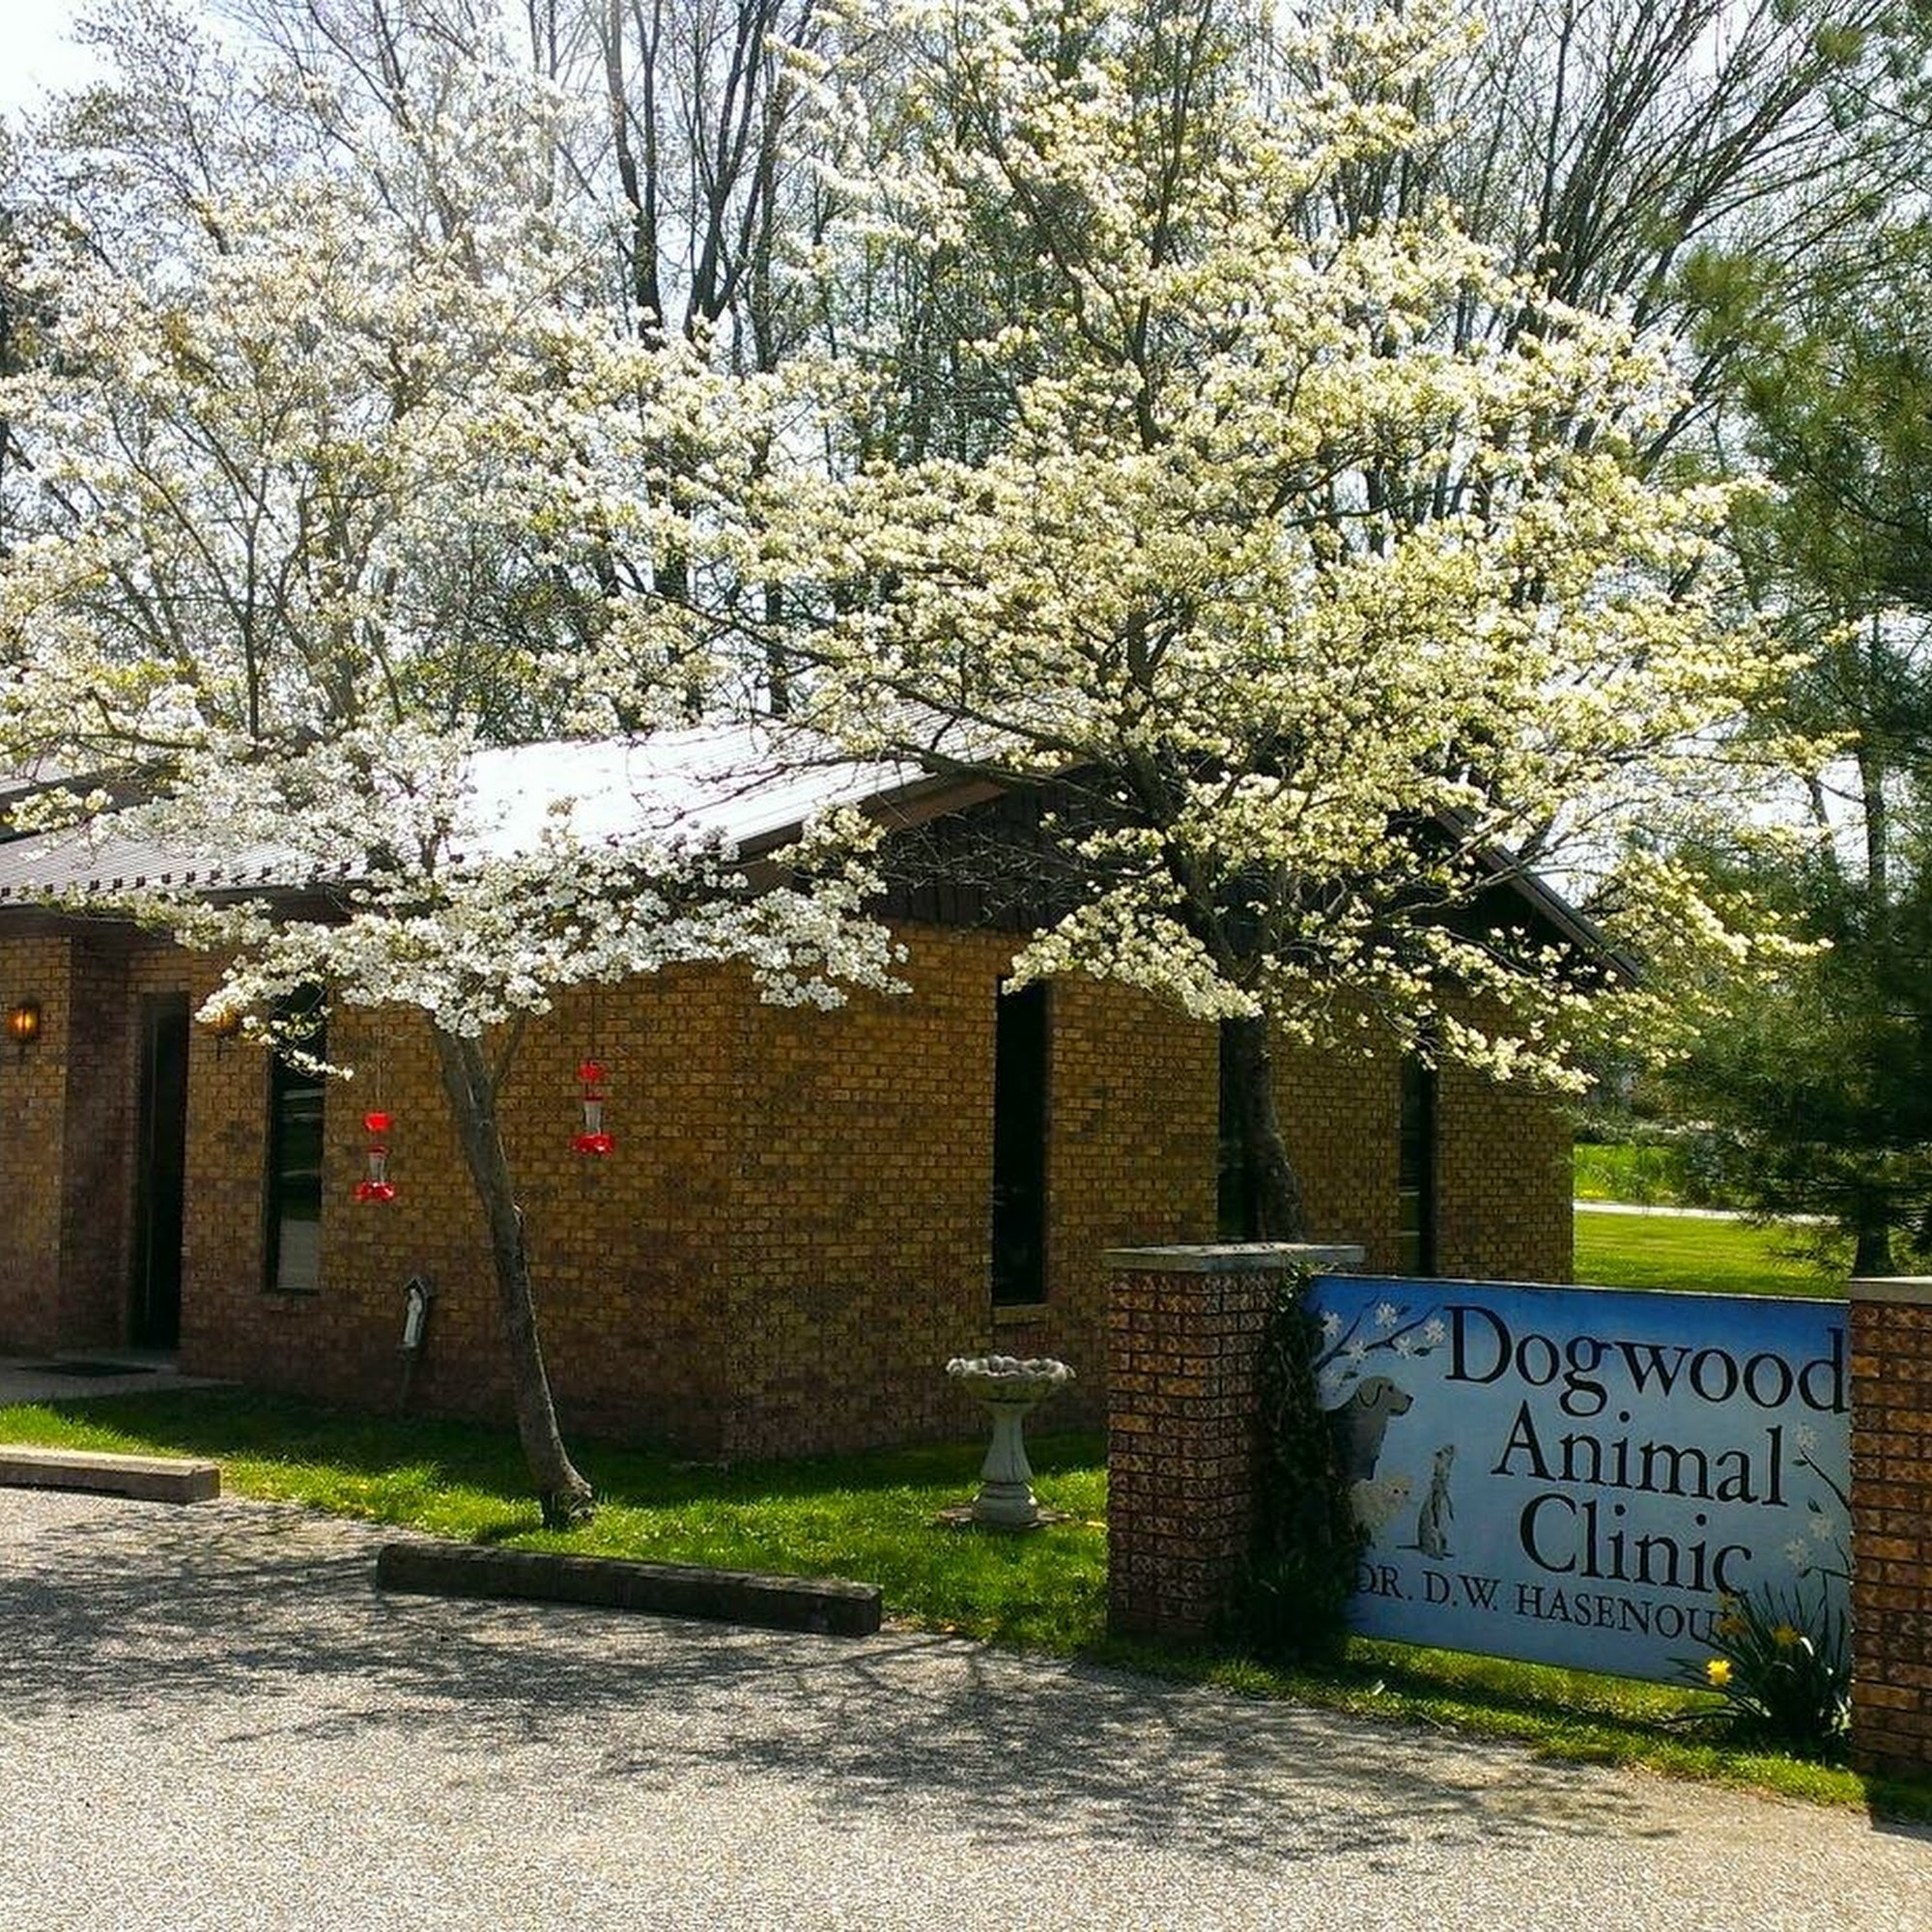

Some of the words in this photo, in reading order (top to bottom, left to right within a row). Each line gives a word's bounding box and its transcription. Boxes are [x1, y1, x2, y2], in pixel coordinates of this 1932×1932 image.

[1443, 1304, 1850, 1416] Dogwood
[1491, 1399, 1788, 1508] Animal
[1520, 1493, 1752, 1597] Clinic
[1352, 1560, 1412, 1601] DR.
[1422, 1570, 1500, 1611] D.W.
[1516, 1582, 1729, 1644] HASENOU
